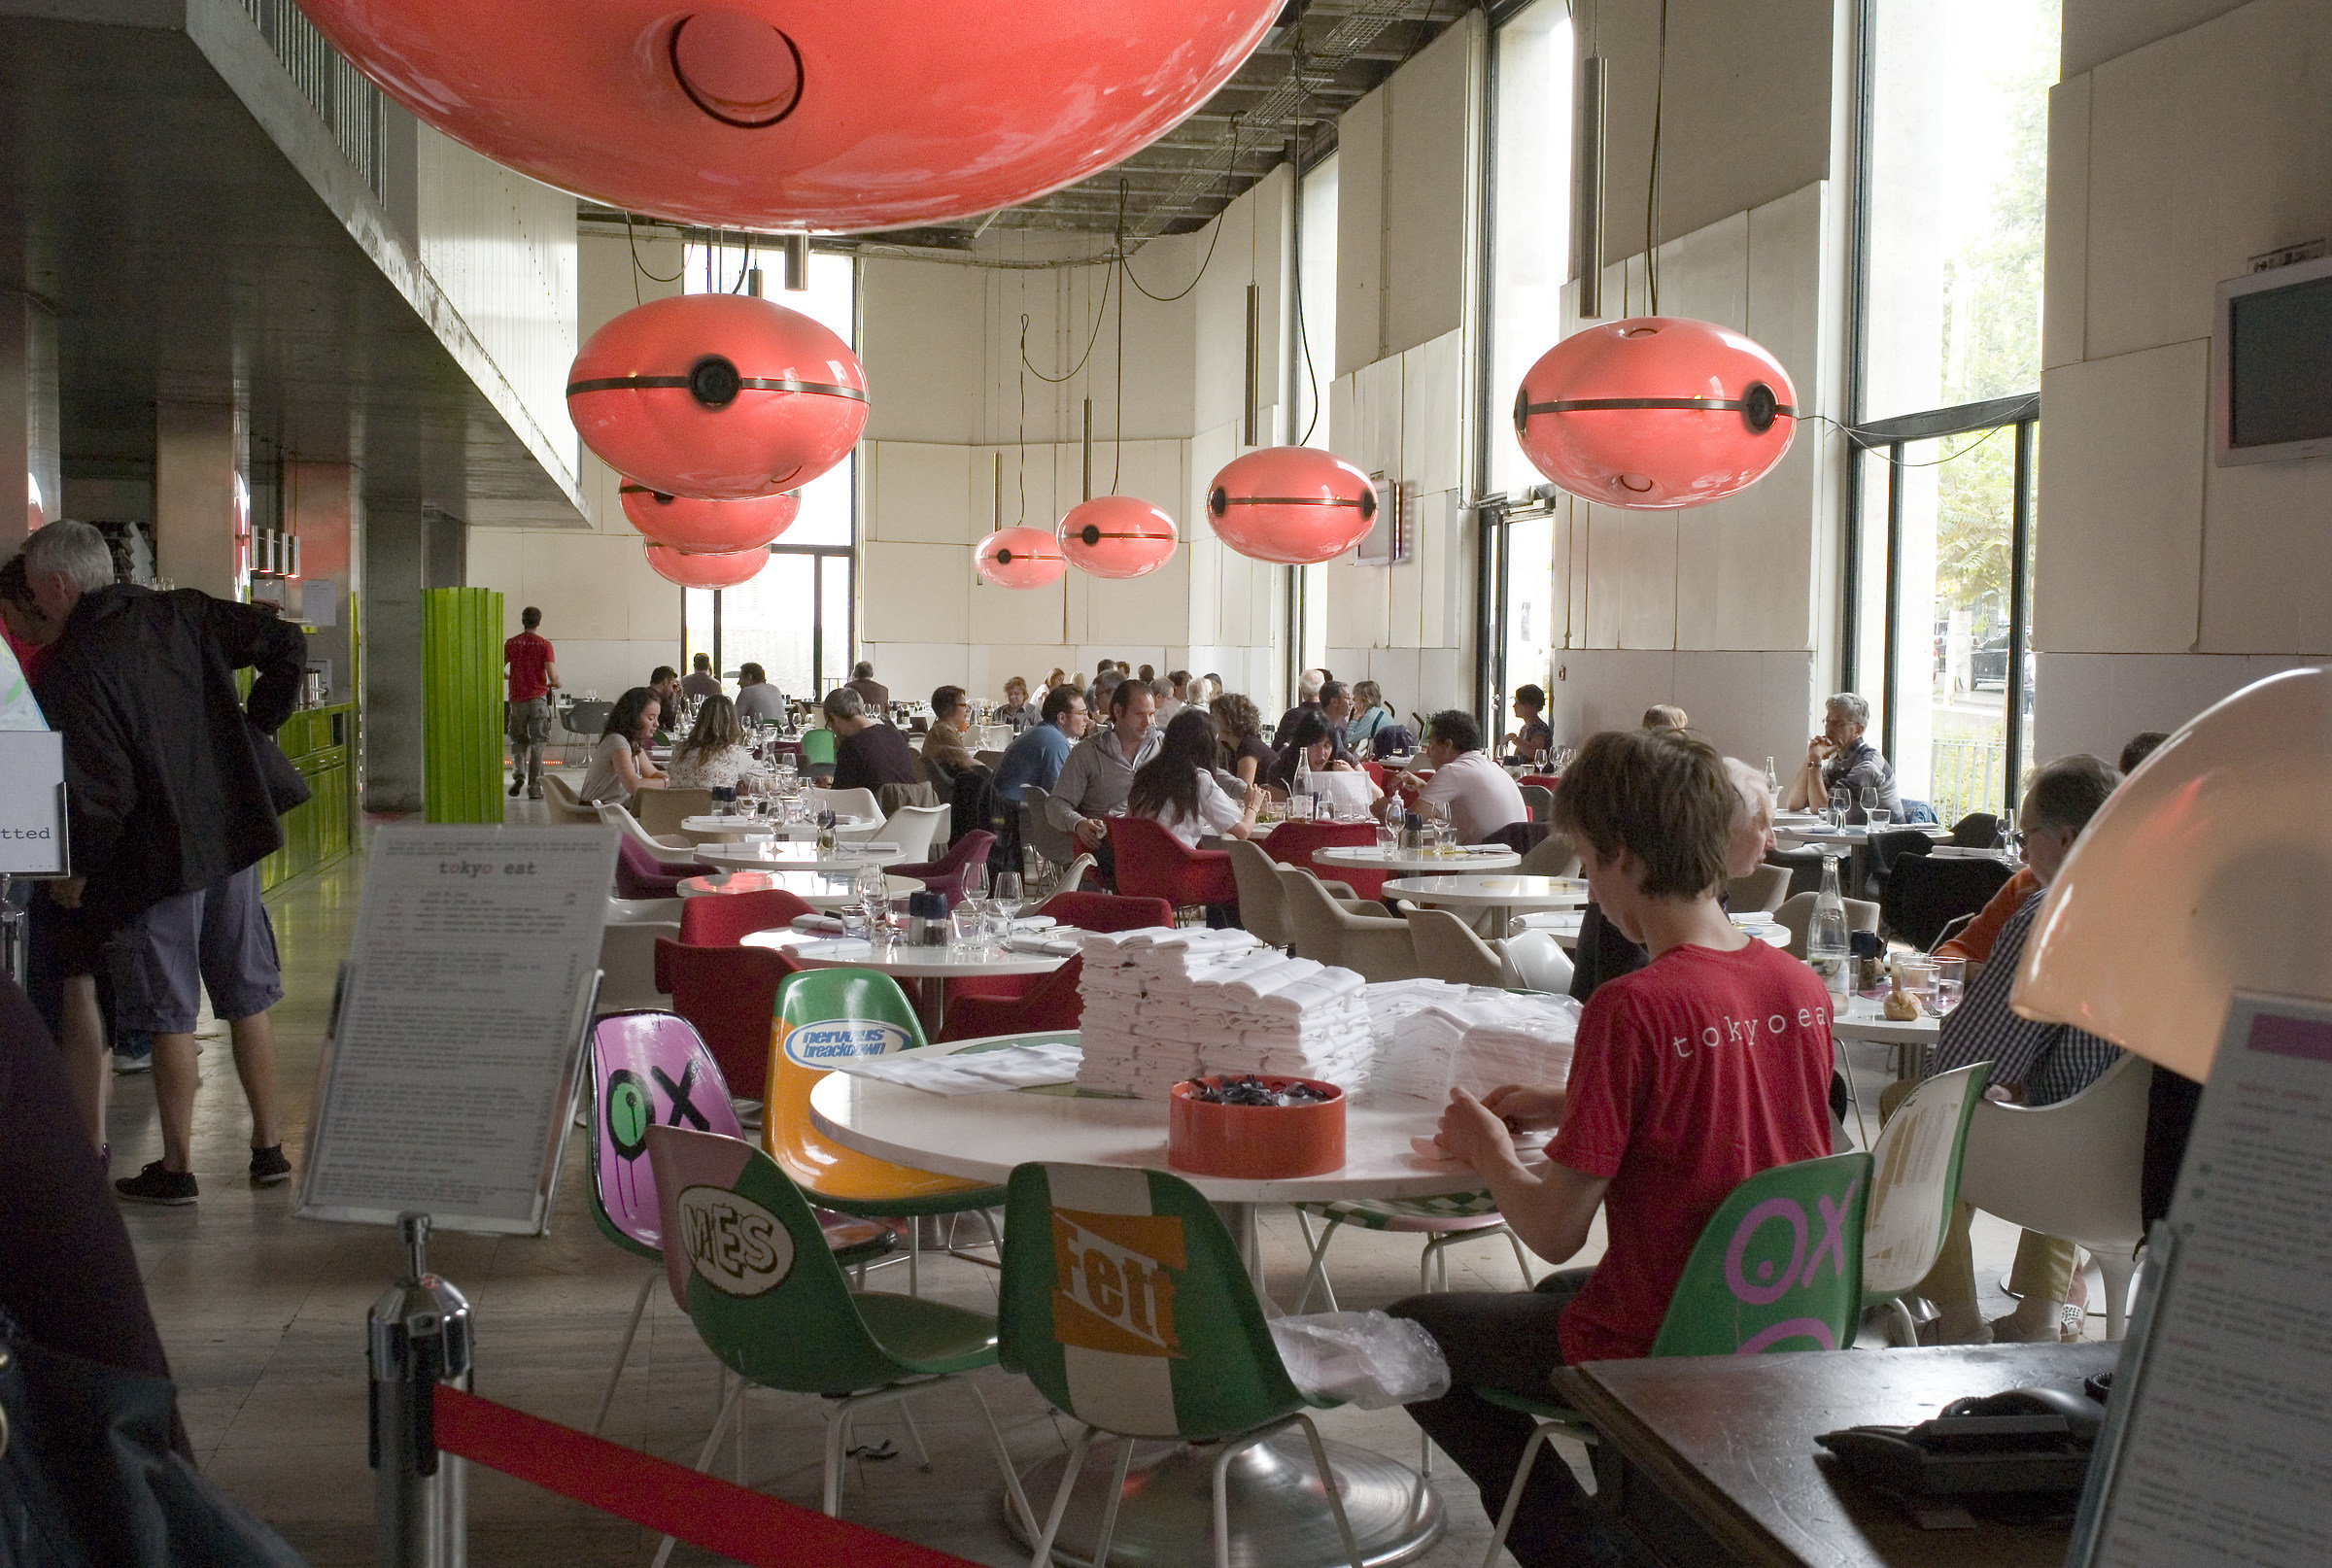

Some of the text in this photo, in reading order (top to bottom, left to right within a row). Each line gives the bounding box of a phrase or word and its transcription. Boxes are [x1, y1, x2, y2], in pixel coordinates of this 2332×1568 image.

[439, 860, 537, 878] tokyo eat
[803, 1029, 885, 1043] nervous
[1672, 1014, 1787, 1057] tokyo
[803, 1041, 886, 1058] breackdown
